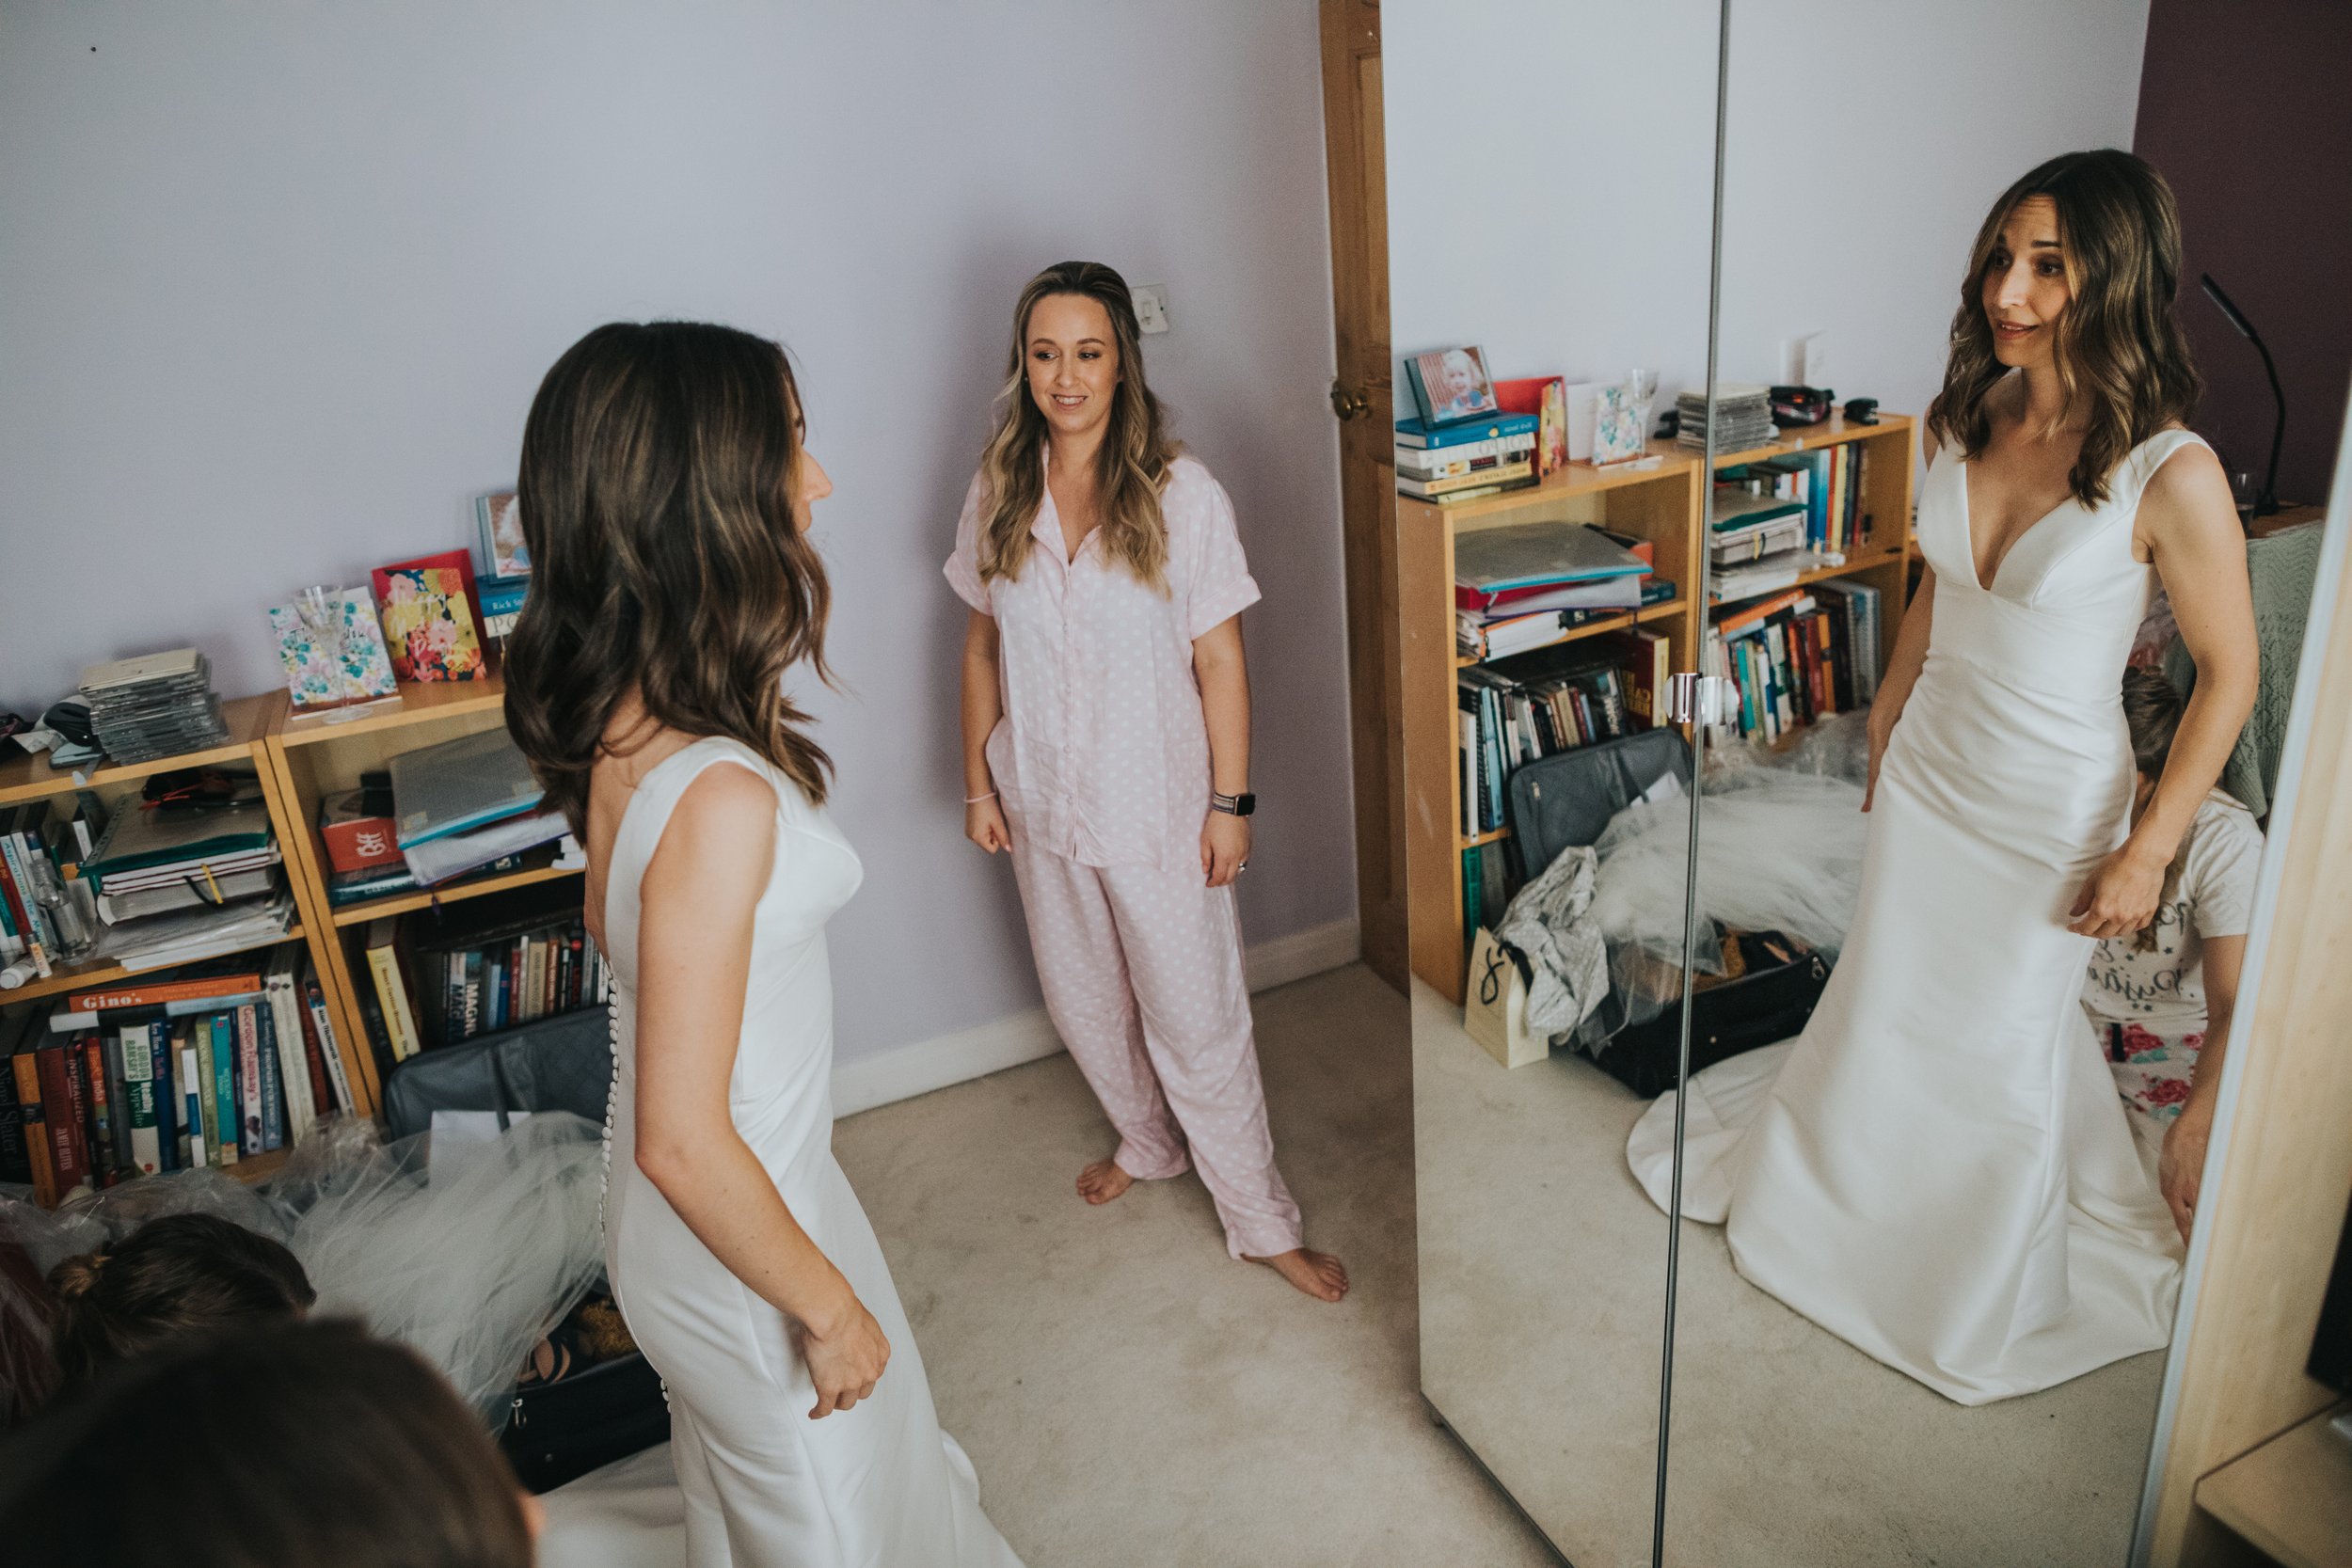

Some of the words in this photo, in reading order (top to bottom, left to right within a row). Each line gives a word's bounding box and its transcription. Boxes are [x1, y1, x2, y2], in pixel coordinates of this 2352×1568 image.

[492, 600, 510, 610] Rick
[3, 840, 27, 897] Aspirations
[24, 899, 36, 916] The
[83, 992, 142, 1009] Gino's
[151, 1022, 163, 1036] Ken
[241, 1006, 258, 1049] Gordon
[124, 1039, 140, 1080] RAMSAY'S
[136, 1044, 151, 1080] GORDON
[244, 1050, 262, 1102] Ramsay's
[0, 1067, 14, 1107] Nigel
[68, 1058, 85, 1124] INSPIRALIZED
[91, 1079, 105, 1102] India
[128, 1084, 146, 1128] Appetite
[138, 1081, 155, 1115] Healthy
[0, 1110, 19, 1154] Slater
[56, 1127, 71, 1148] JAMIE
[58, 1147, 74, 1171] OLIVER
